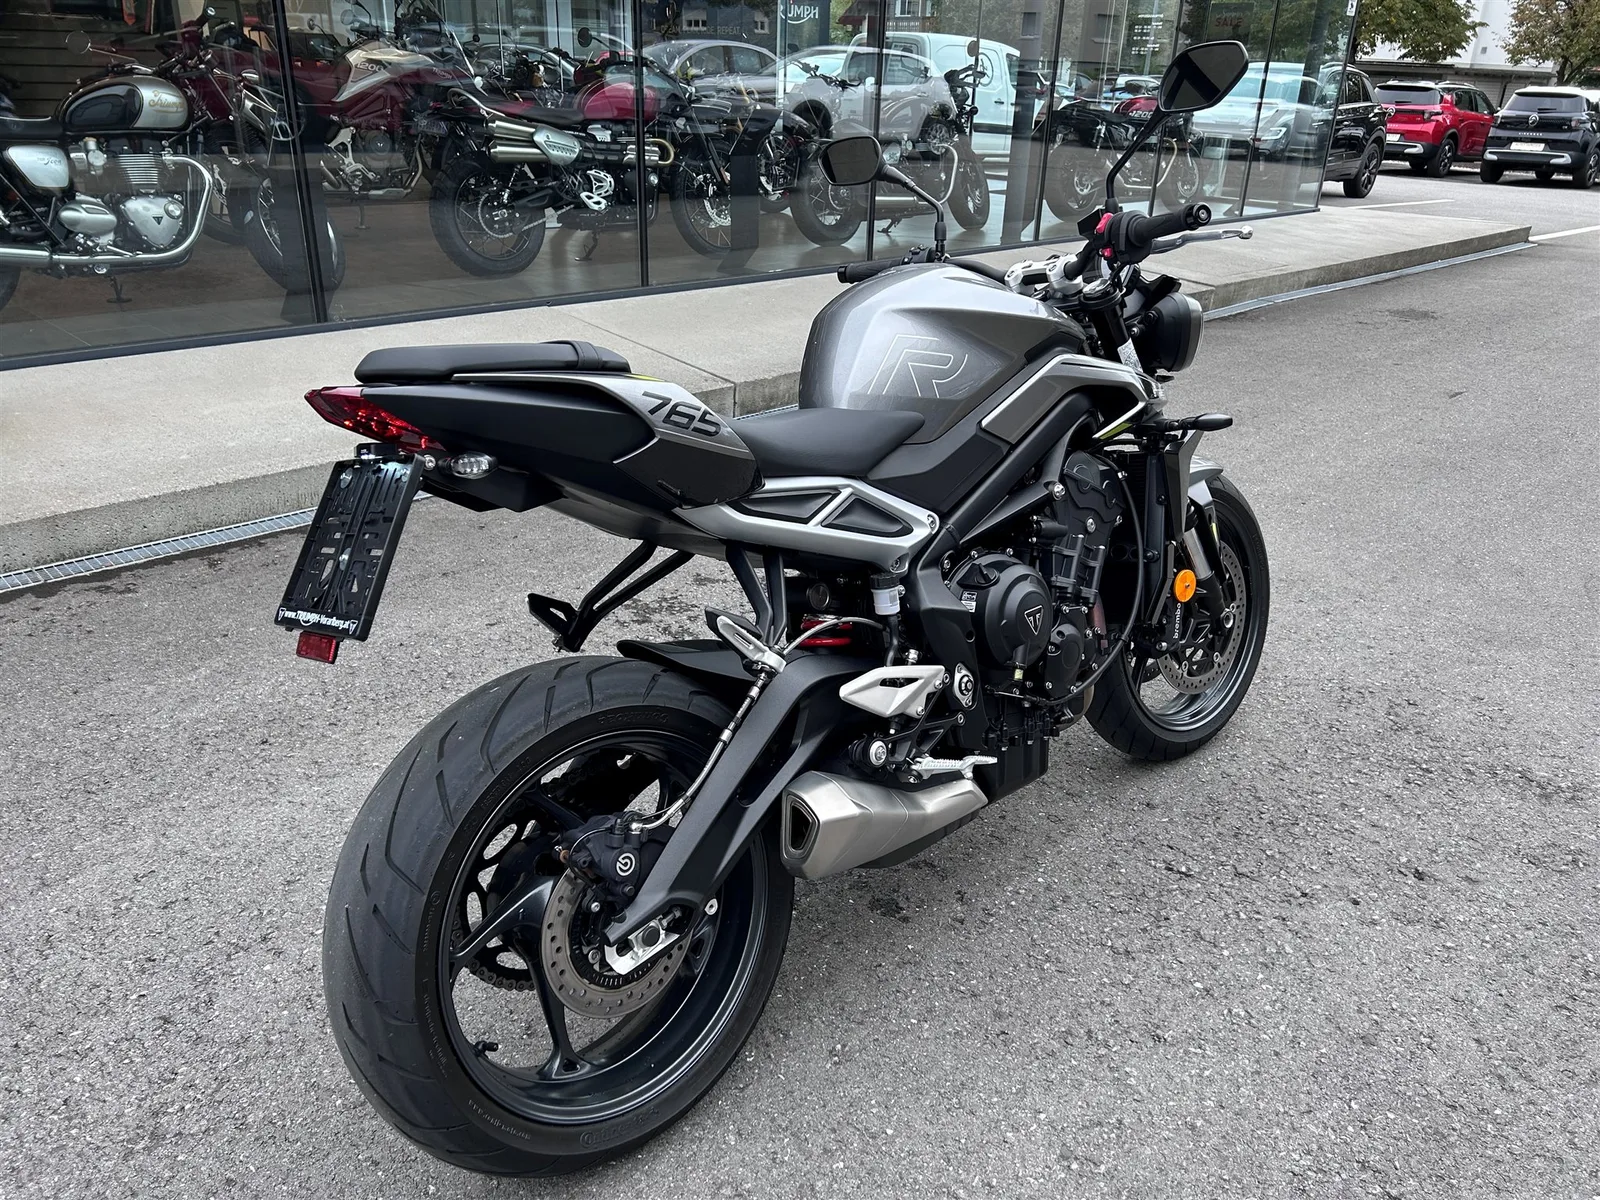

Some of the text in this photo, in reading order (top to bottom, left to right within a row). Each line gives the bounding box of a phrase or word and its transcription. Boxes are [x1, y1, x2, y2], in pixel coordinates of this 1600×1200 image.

[867, 334, 968, 399] R
[641, 390, 722, 437] 765
[1172, 602, 1182, 639] brembo
